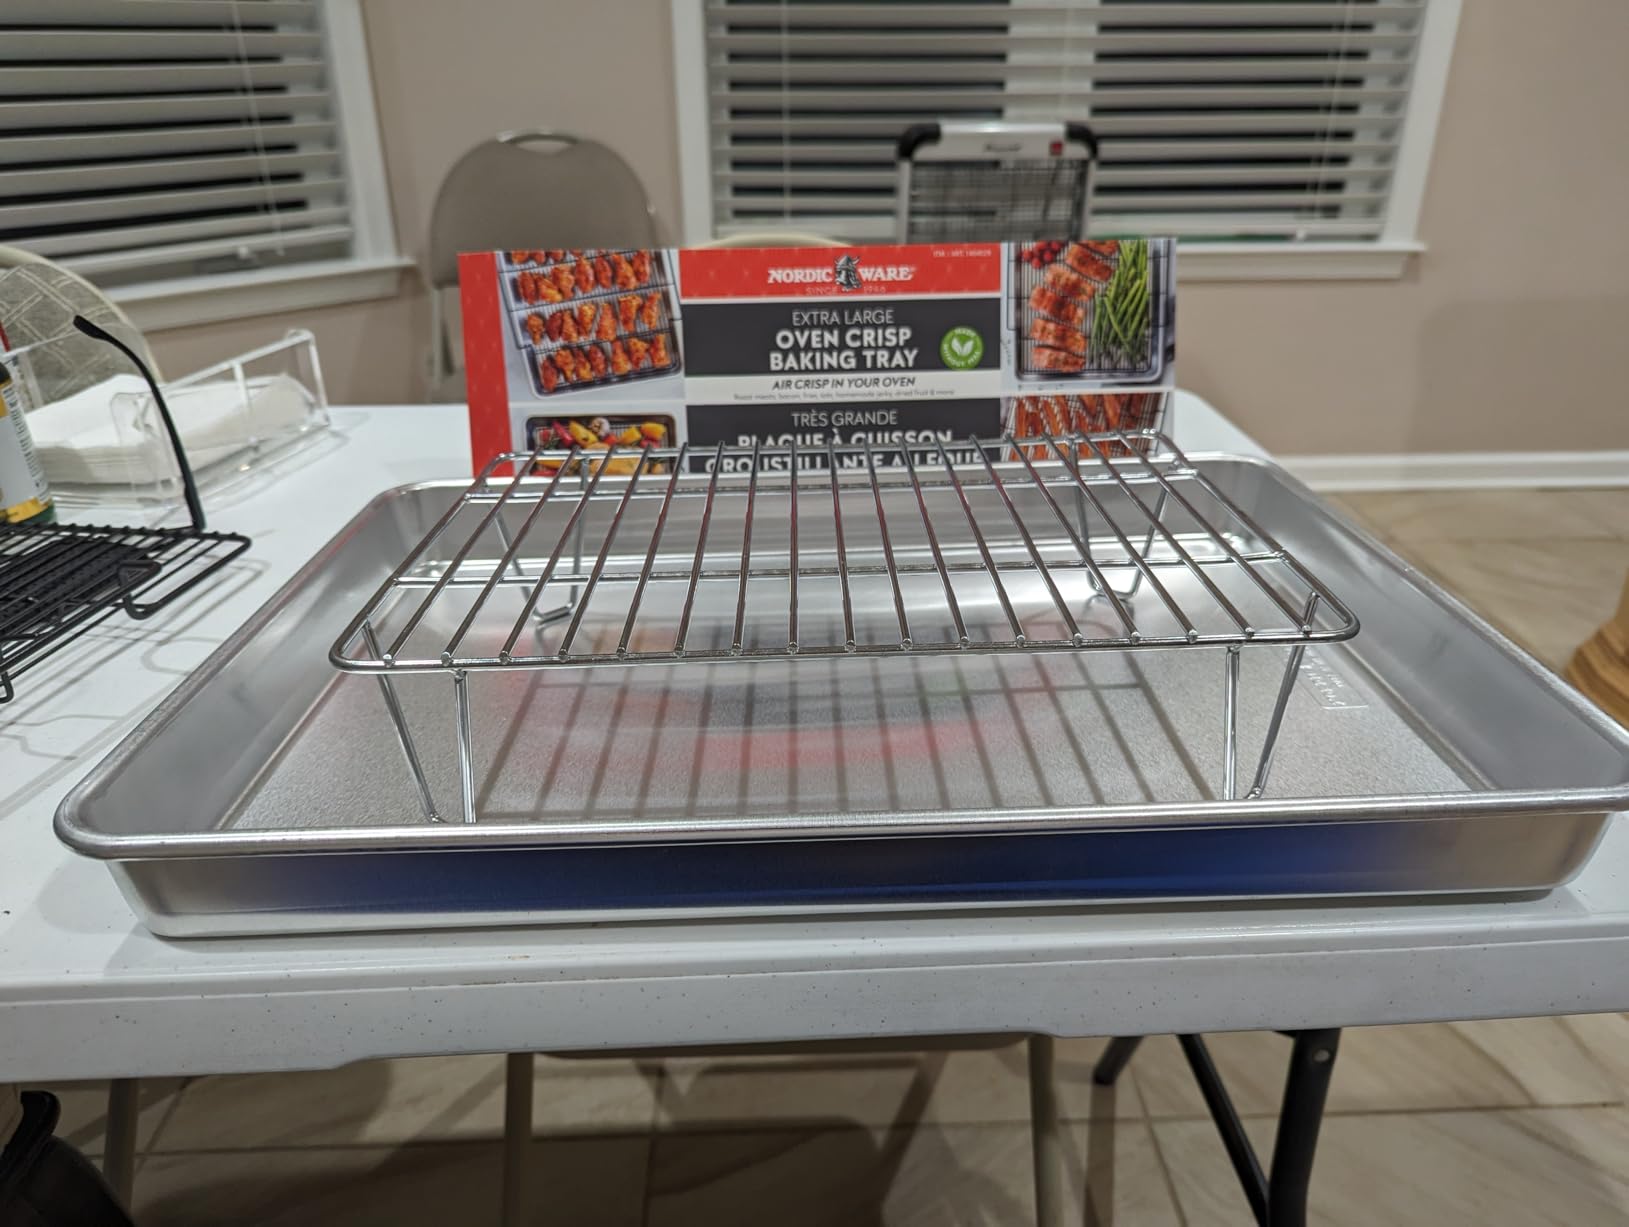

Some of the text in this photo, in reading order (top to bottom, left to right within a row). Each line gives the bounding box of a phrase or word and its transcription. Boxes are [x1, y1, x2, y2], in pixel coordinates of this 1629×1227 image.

[768, 266, 833, 284] NORDIC
[792, 309, 895, 327] EXTRA LARGE
[775, 327, 912, 350] OVEN CRISP
[769, 347, 919, 372] BAKING TRAY
[772, 376, 916, 391] AIR CRISP IN YOUR OVEN
[791, 409, 898, 428] TRÈS GRANDE
